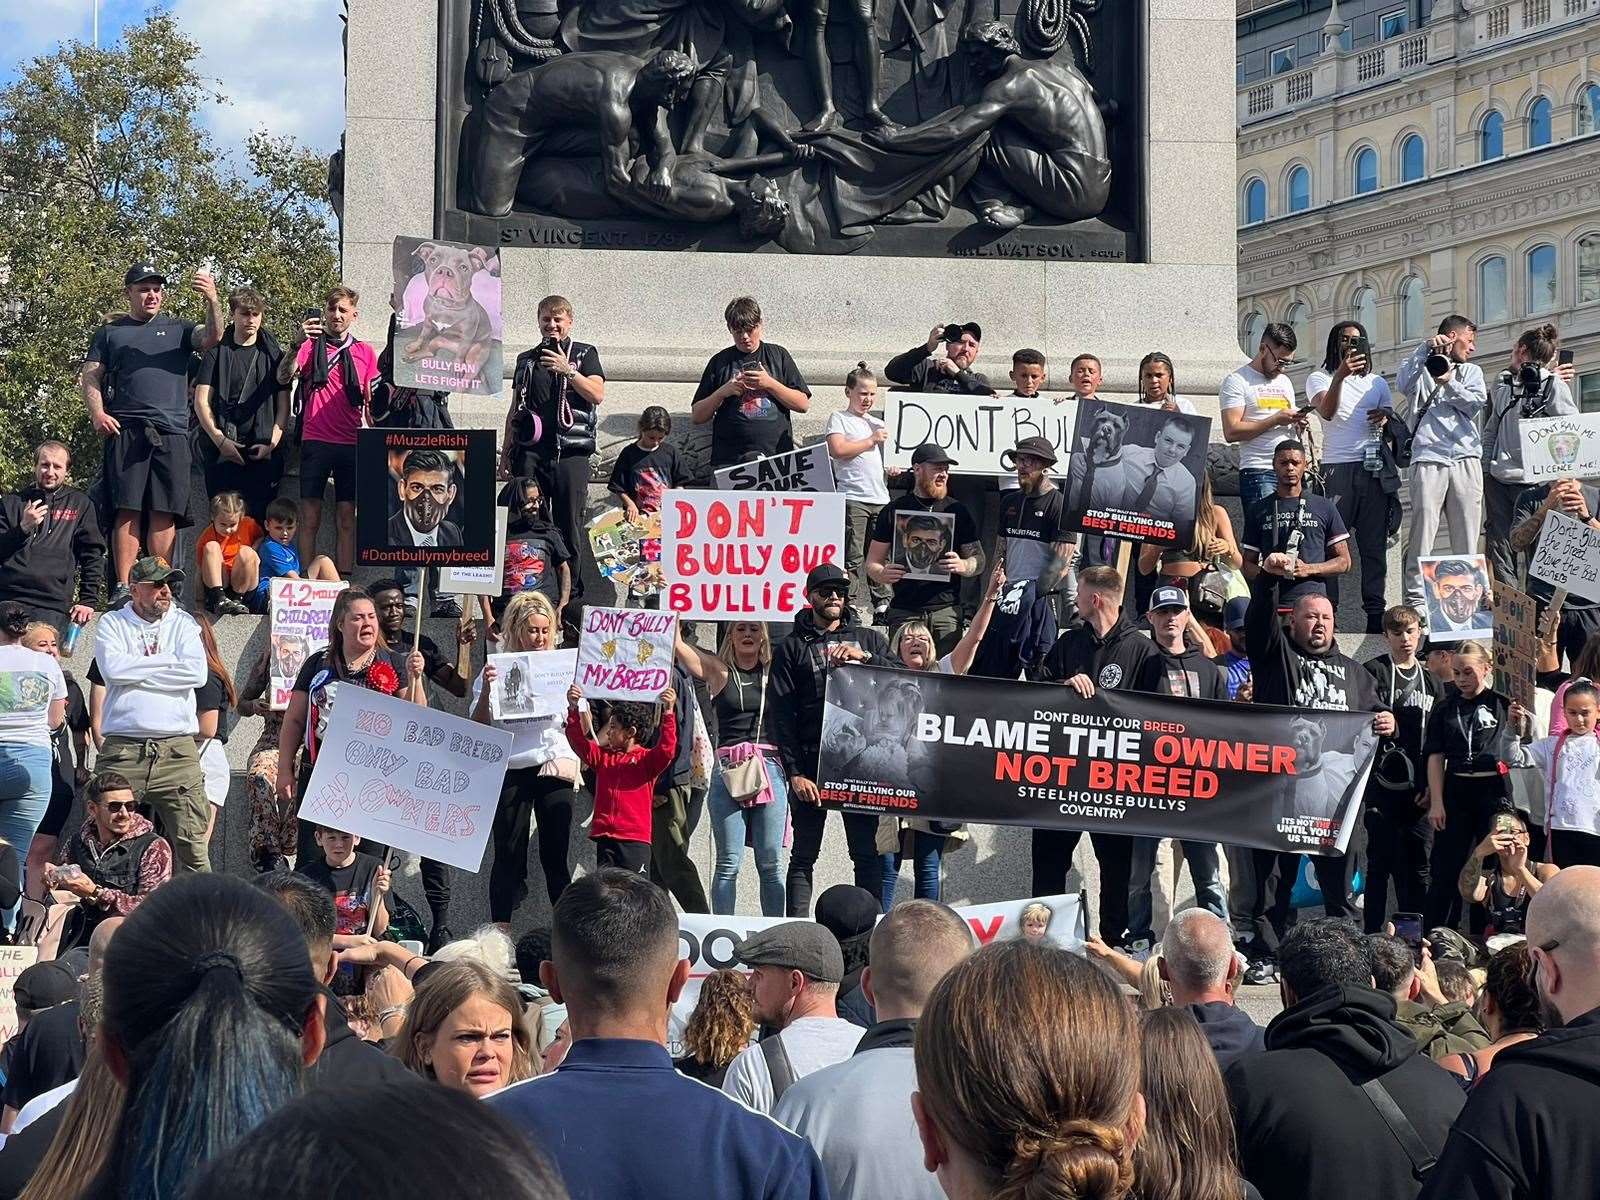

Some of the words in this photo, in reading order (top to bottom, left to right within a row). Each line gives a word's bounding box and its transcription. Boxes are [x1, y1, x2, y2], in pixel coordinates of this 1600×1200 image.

[528, 228, 628, 246] VINCENT
[421, 359, 452, 372] BULLY
[453, 361, 475, 373] BAN
[415, 374, 438, 385] LETS
[443, 377, 469, 388] FIGHT
[471, 379, 482, 389] IT
[894, 399, 1004, 454] DONT
[1560, 421, 1581, 432] BAN
[1581, 429, 1596, 439] ME
[386, 434, 468, 447] #MuzzleRishi
[728, 449, 815, 488] SAVE
[756, 473, 809, 491] OUR
[675, 497, 814, 539] DON'T
[1082, 516, 1116, 530] BEST
[1119, 522, 1176, 540] FRIENDS
[1086, 509, 1110, 519] STOP
[1111, 512, 1154, 526] BULLYING
[1154, 520, 1174, 529] OUR
[1301, 520, 1318, 528] CATS
[1544, 535, 1560, 550] the
[362, 549, 489, 564] #Dontbullymybreed
[676, 543, 773, 576] BULLY
[781, 544, 836, 574] OUR
[1535, 546, 1561, 568] Blame
[1563, 558, 1580, 575] the
[628, 612, 674, 637] BULLY
[583, 663, 613, 687] MY
[607, 664, 668, 691] BREED
[1034, 710, 1069, 723] DONT
[1072, 713, 1111, 727] BULLY
[1113, 717, 1141, 730] OUR
[1144, 720, 1185, 734] BREED
[355, 708, 393, 737] NO
[403, 720, 446, 747] BAD
[449, 731, 504, 764] BREED
[916, 712, 1050, 754] BLAME
[1063, 725, 1141, 762] THE
[1154, 735, 1298, 775] OWNER
[345, 739, 408, 777] ONLY
[414, 761, 470, 795] BAD
[994, 752, 1076, 786] NOT
[1088, 760, 1219, 800] BREED
[820, 789, 855, 802] BEST
[858, 792, 918, 809] FRIENDS
[824, 781, 849, 791] STOP
[850, 784, 894, 796] BULLYING
[895, 789, 916, 798] OUR
[1018, 787, 1187, 811] STEELHOUSEBULLYS
[359, 778, 481, 837] OWNERS
[1059, 803, 1127, 820] COVENTRY
[1277, 824, 1308, 835] UNTIL
[1309, 827, 1331, 837] YOU
[1281, 817, 1296, 825] ITS
[1296, 818, 1314, 827] NOT
[1287, 834, 1301, 843] US
[1302, 836, 1320, 845] THE
